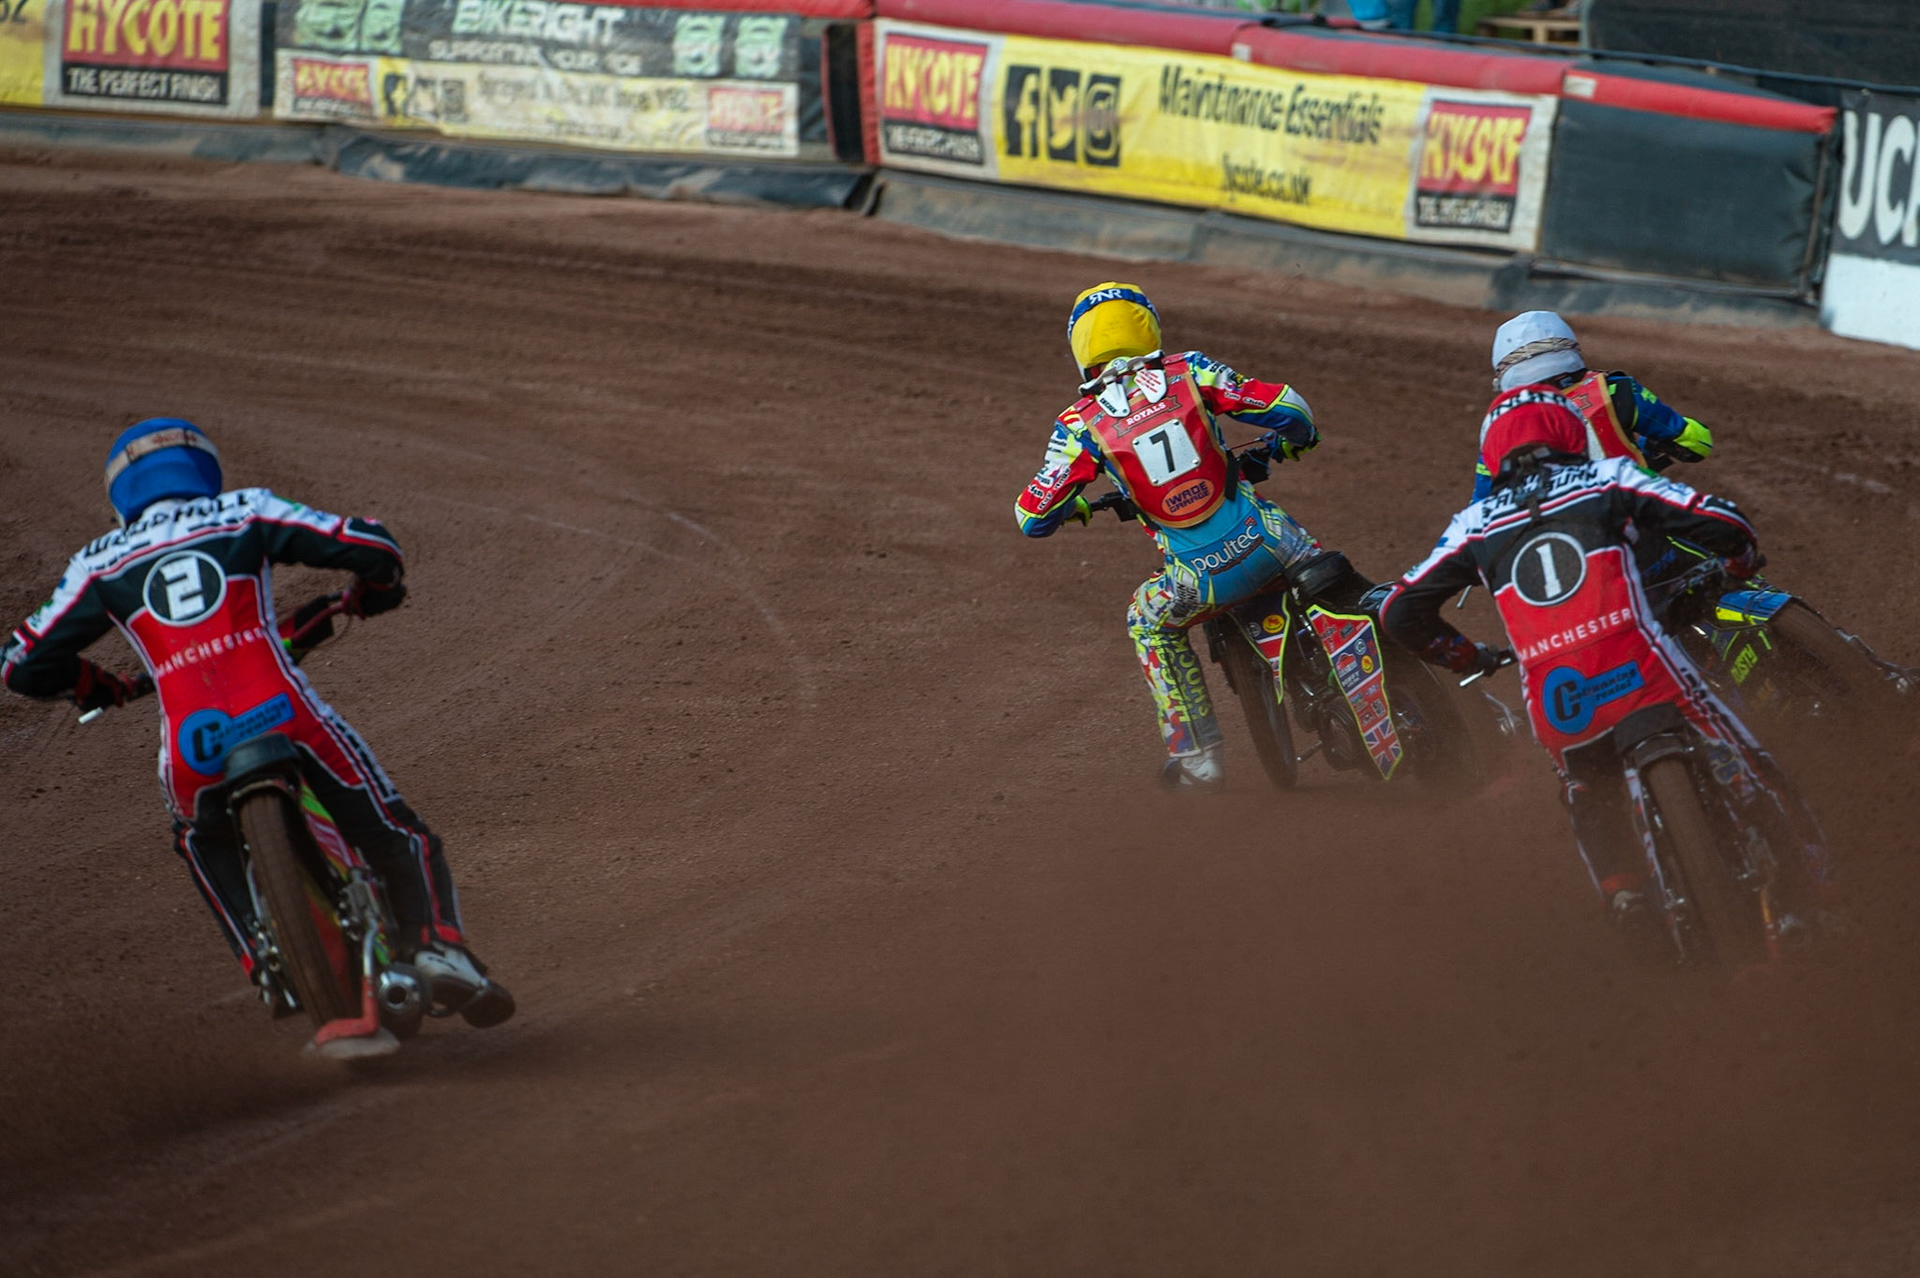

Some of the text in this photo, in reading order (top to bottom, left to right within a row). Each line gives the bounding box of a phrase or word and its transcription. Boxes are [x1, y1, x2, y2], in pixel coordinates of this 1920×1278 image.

[99, 69, 169, 97] PERFECT
[1125, 402, 1167, 426] ROYALS
[1149, 429, 1177, 474] 7
[1190, 525, 1261, 578] poultec
[1535, 542, 1562, 600] 1
[159, 555, 206, 621] 2
[1519, 607, 1633, 661] MANCHESTER
